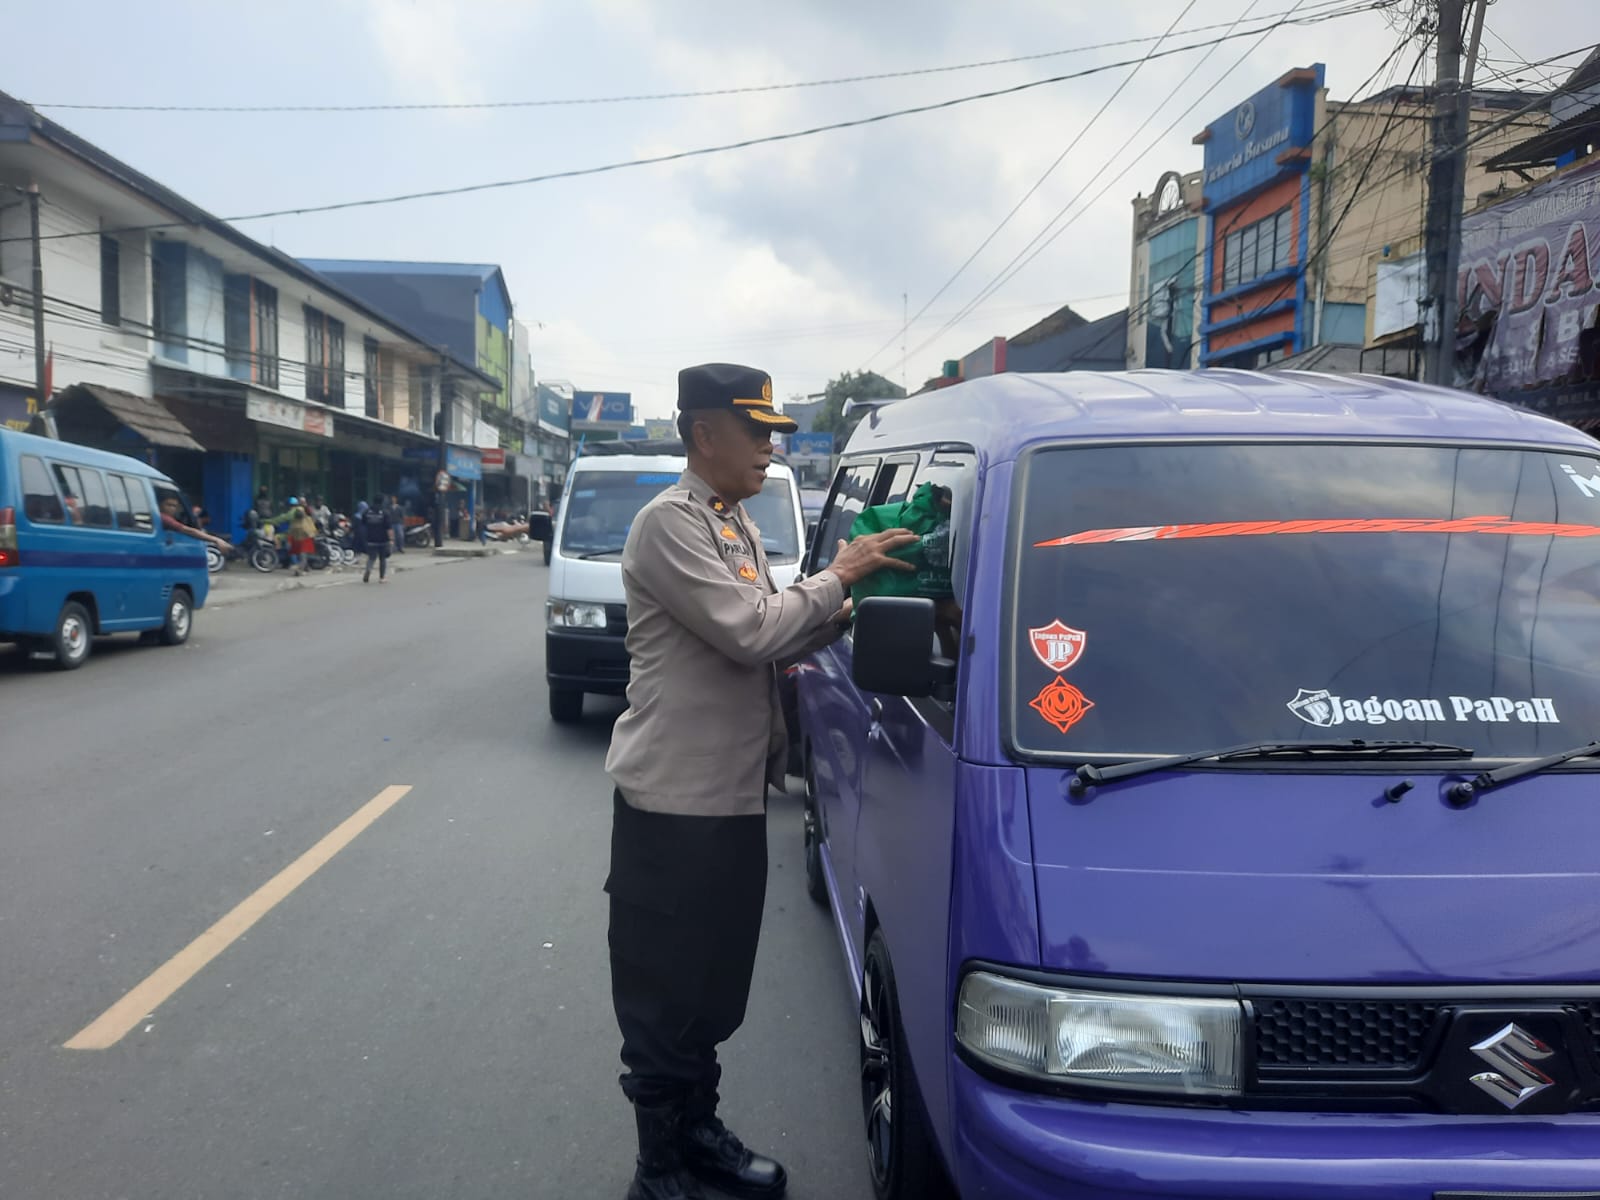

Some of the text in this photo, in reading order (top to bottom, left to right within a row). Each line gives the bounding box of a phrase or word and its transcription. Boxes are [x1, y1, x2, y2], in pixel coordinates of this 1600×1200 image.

[1046, 640, 1074, 663] JP
[1329, 696, 1446, 725] Jagoan
[1448, 696, 1561, 723] PaPaH
